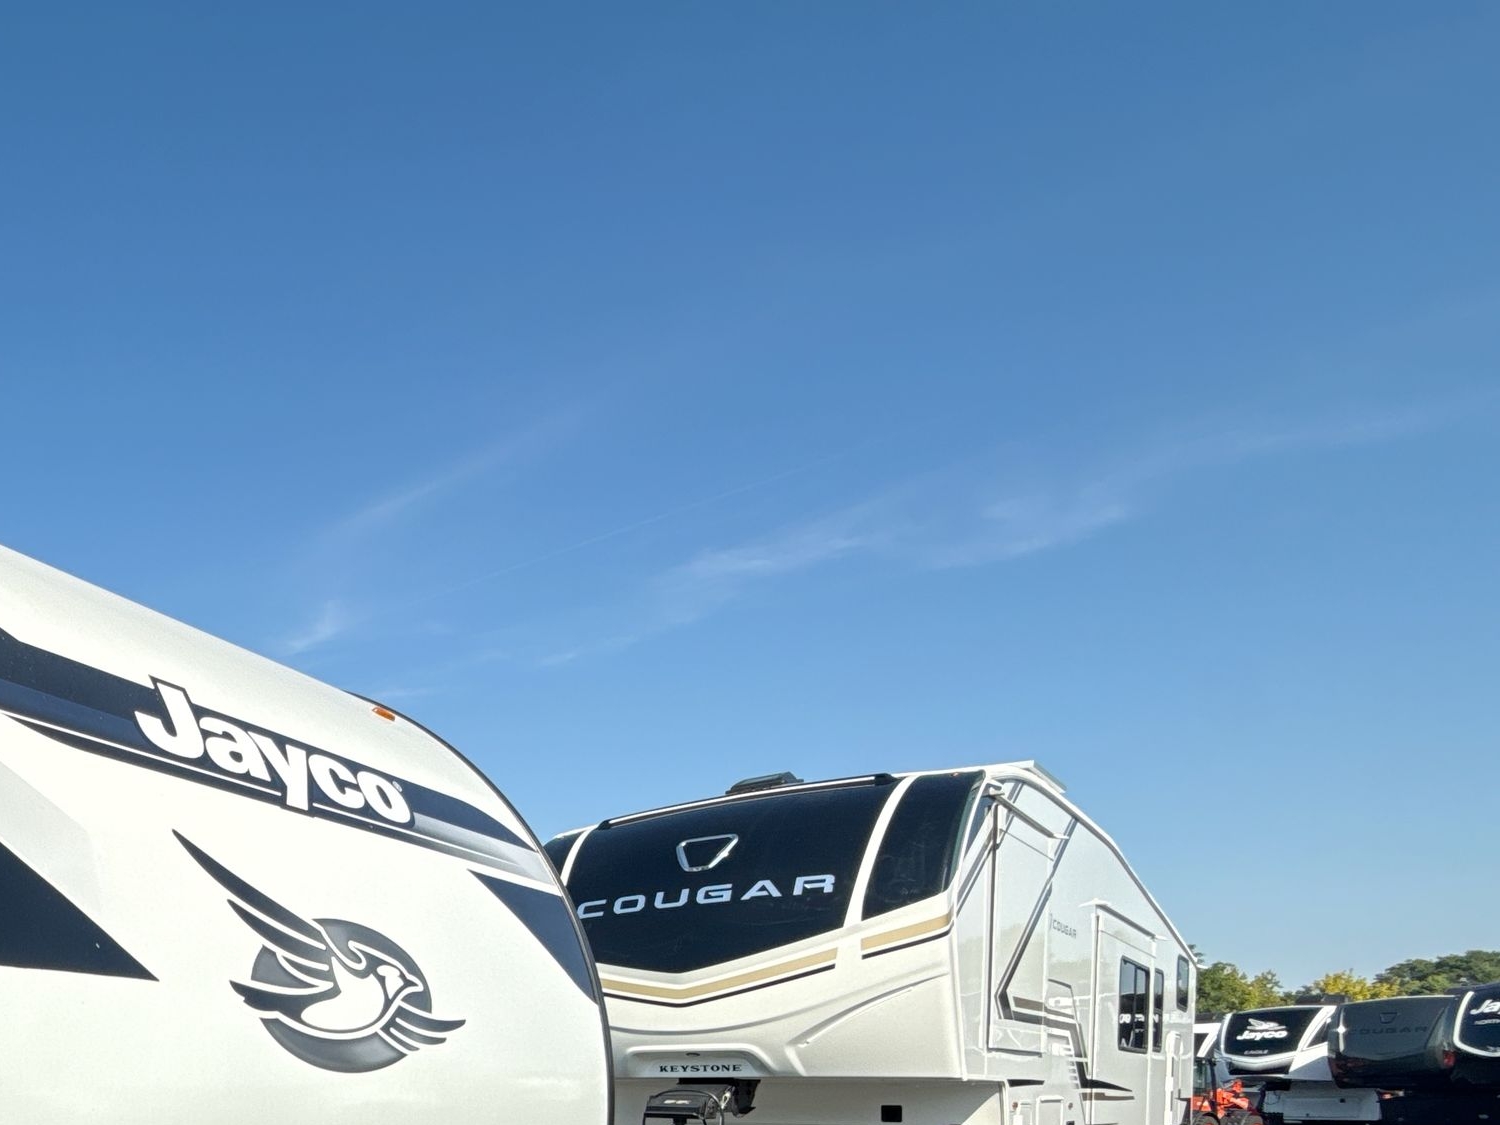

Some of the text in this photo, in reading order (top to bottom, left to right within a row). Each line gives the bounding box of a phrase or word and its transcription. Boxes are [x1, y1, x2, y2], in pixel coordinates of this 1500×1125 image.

[133, 680, 412, 824] Jayco
[577, 874, 836, 920] COUGAR
[1236, 1030, 1289, 1041] Jayco
[659, 1064, 743, 1074] KEYSTONE
